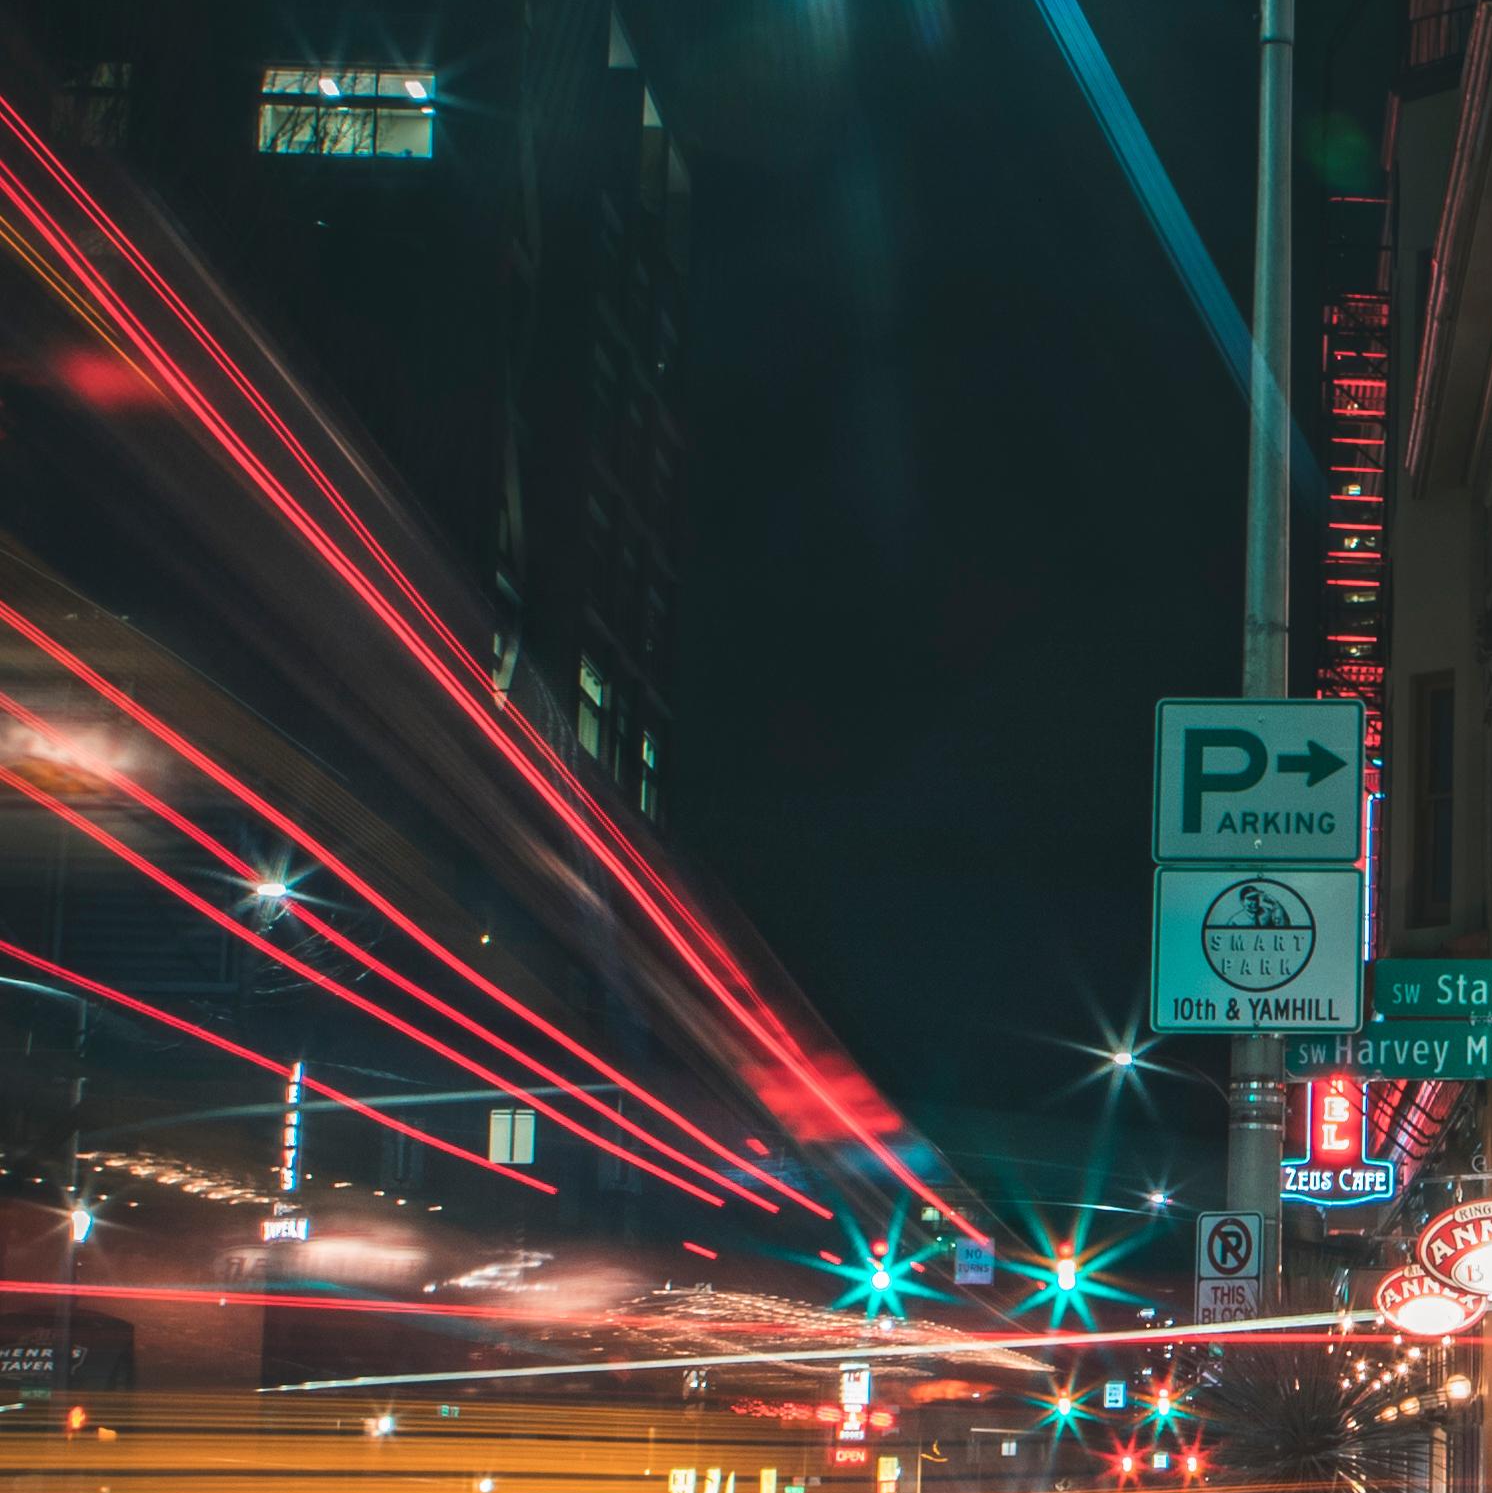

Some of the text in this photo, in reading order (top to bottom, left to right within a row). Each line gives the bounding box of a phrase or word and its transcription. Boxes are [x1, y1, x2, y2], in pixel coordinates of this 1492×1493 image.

[1211, 934, 1305, 952] SMART
[1222, 959, 1292, 976] PARK
[1392, 983, 1420, 1004] SW
[1173, 997, 1340, 1021] 10th & YAMHILL
[1299, 1043, 1326, 1064] SW
[1334, 1035, 1449, 1074] Harvey
[966, 1248, 982, 1259] NO
[1211, 1286, 1245, 1305] THIS
[835, 1450, 865, 1462] OPEN
